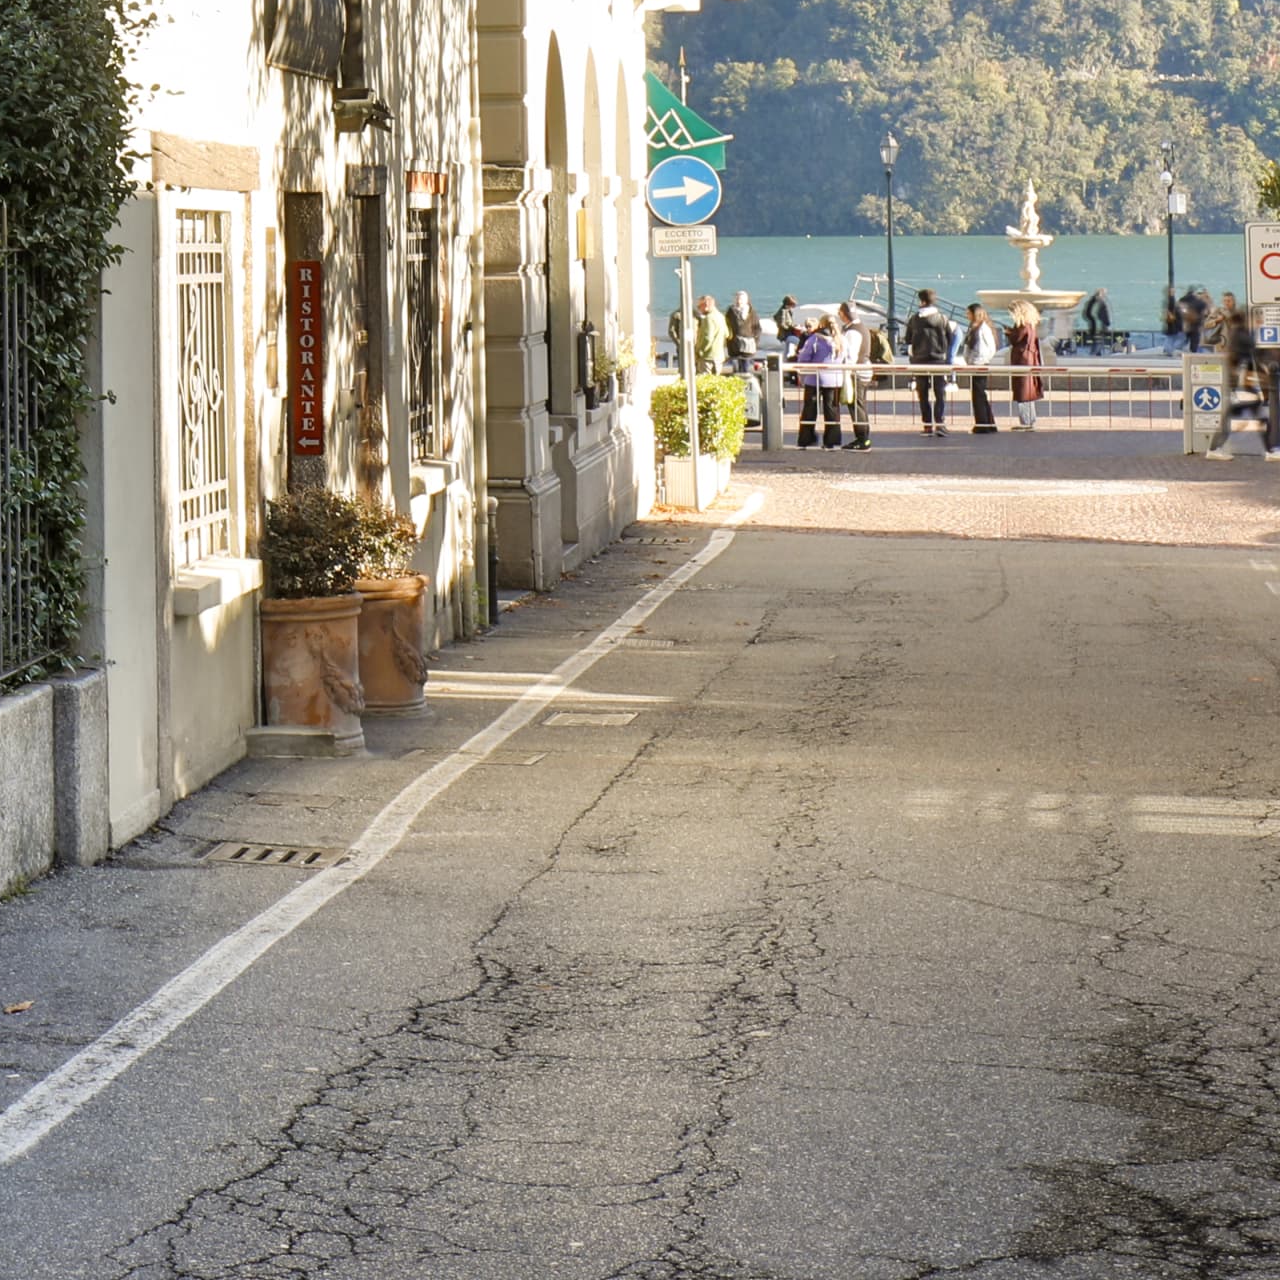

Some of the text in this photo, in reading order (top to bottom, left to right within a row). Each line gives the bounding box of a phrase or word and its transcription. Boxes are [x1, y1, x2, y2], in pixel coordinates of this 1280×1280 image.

[664, 230, 703, 238] ECCETTO
[659, 243, 710, 252] AUTORIZZATI
[299, 268, 315, 431] RISTORANTE
